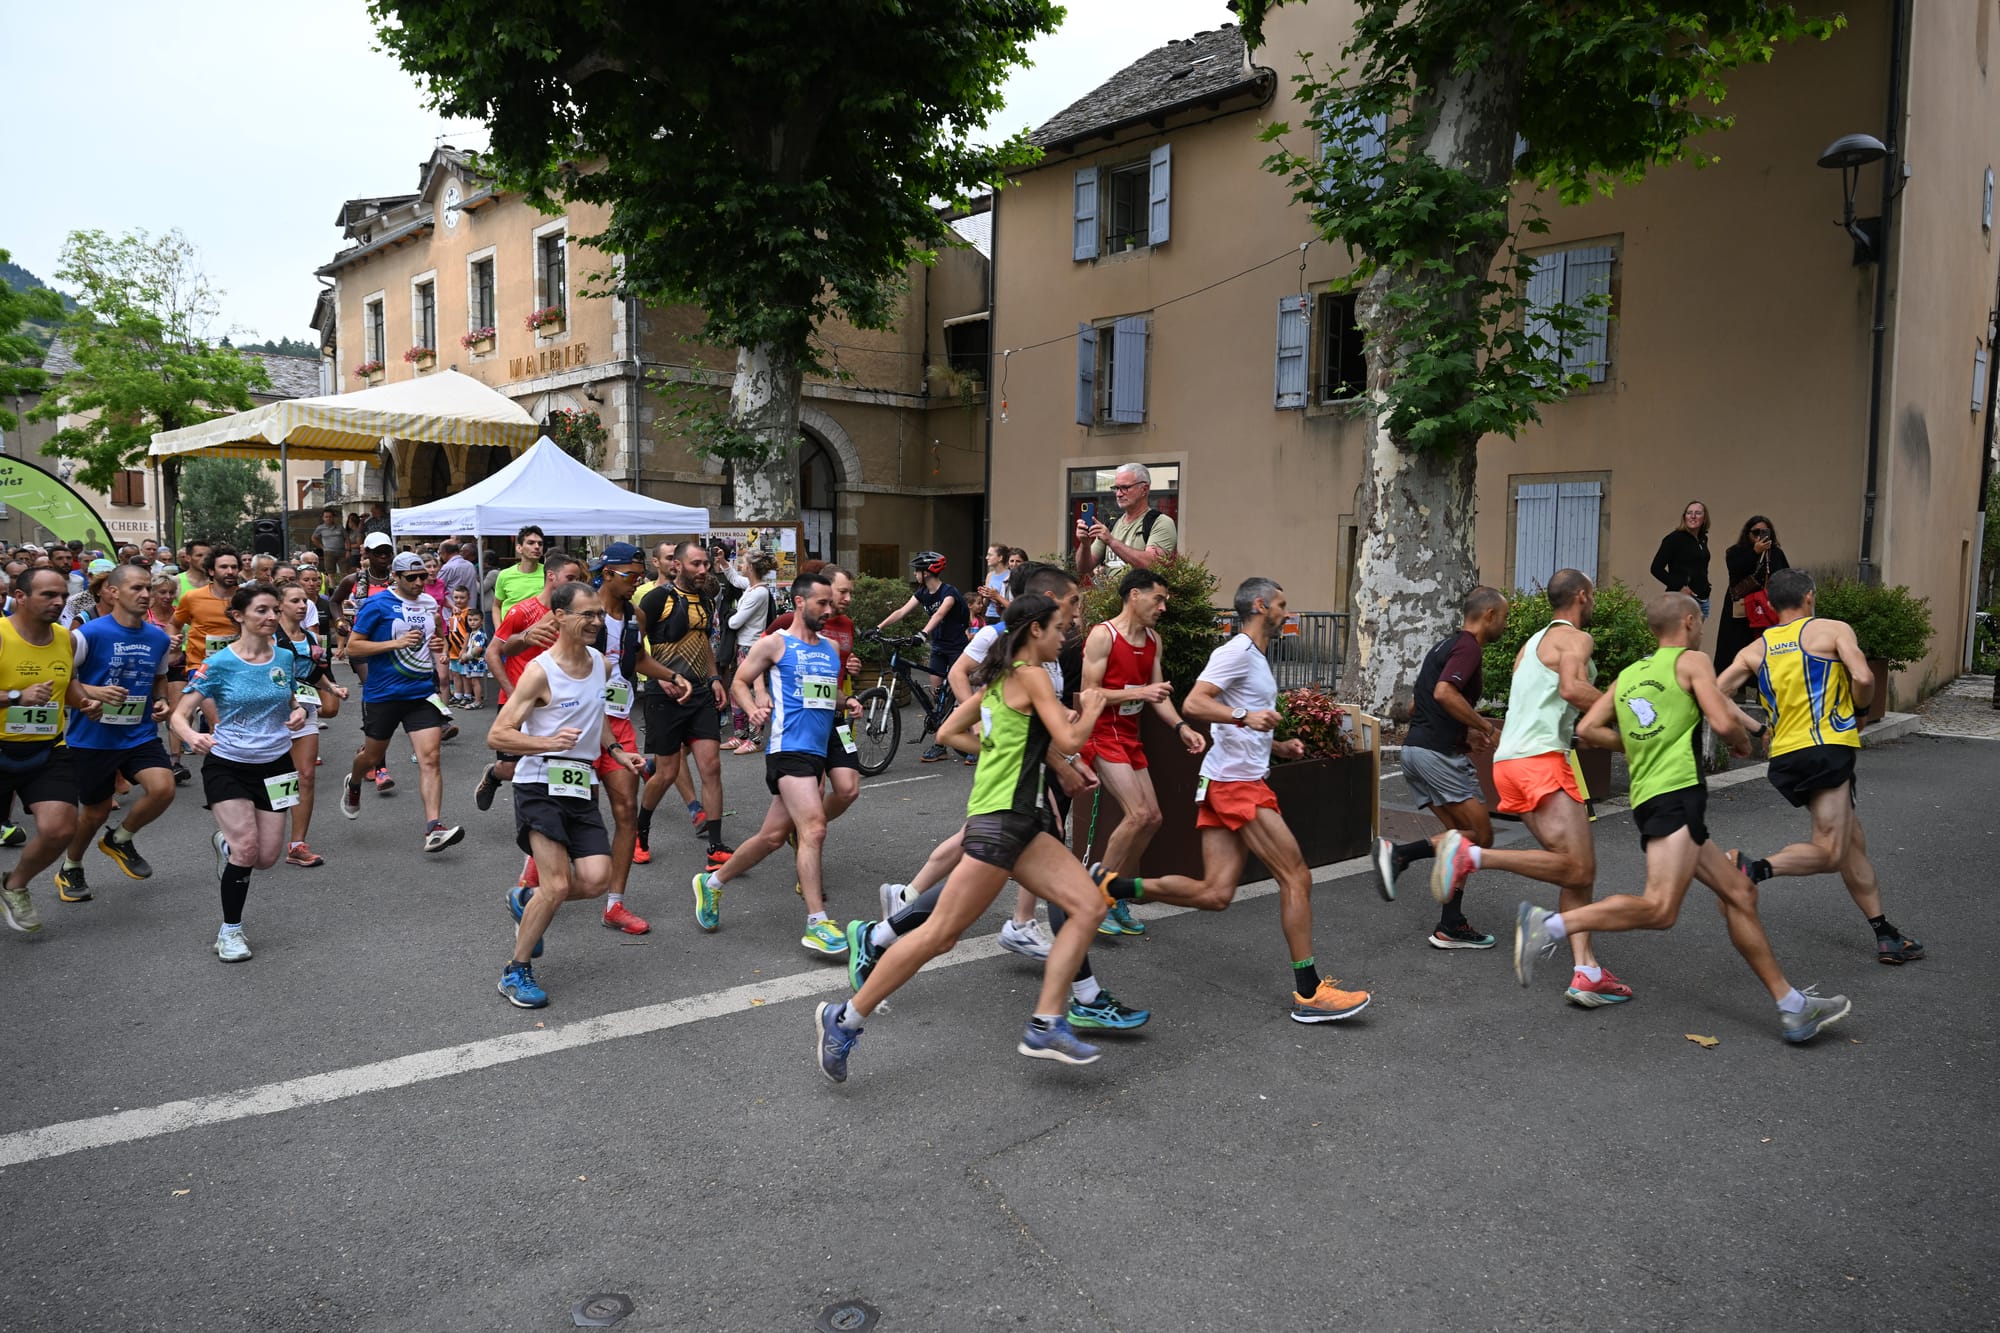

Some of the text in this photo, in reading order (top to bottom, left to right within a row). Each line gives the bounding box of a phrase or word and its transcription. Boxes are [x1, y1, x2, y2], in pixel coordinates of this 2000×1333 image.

[510, 343, 586, 379] MAIRIE
[407, 616, 426, 624] ASSP
[1769, 641, 1798, 651] LUNEL
[814, 684, 831, 698] 70
[117, 703, 137, 715] 77
[23, 709, 48, 724] 15
[562, 769, 584, 786] 82
